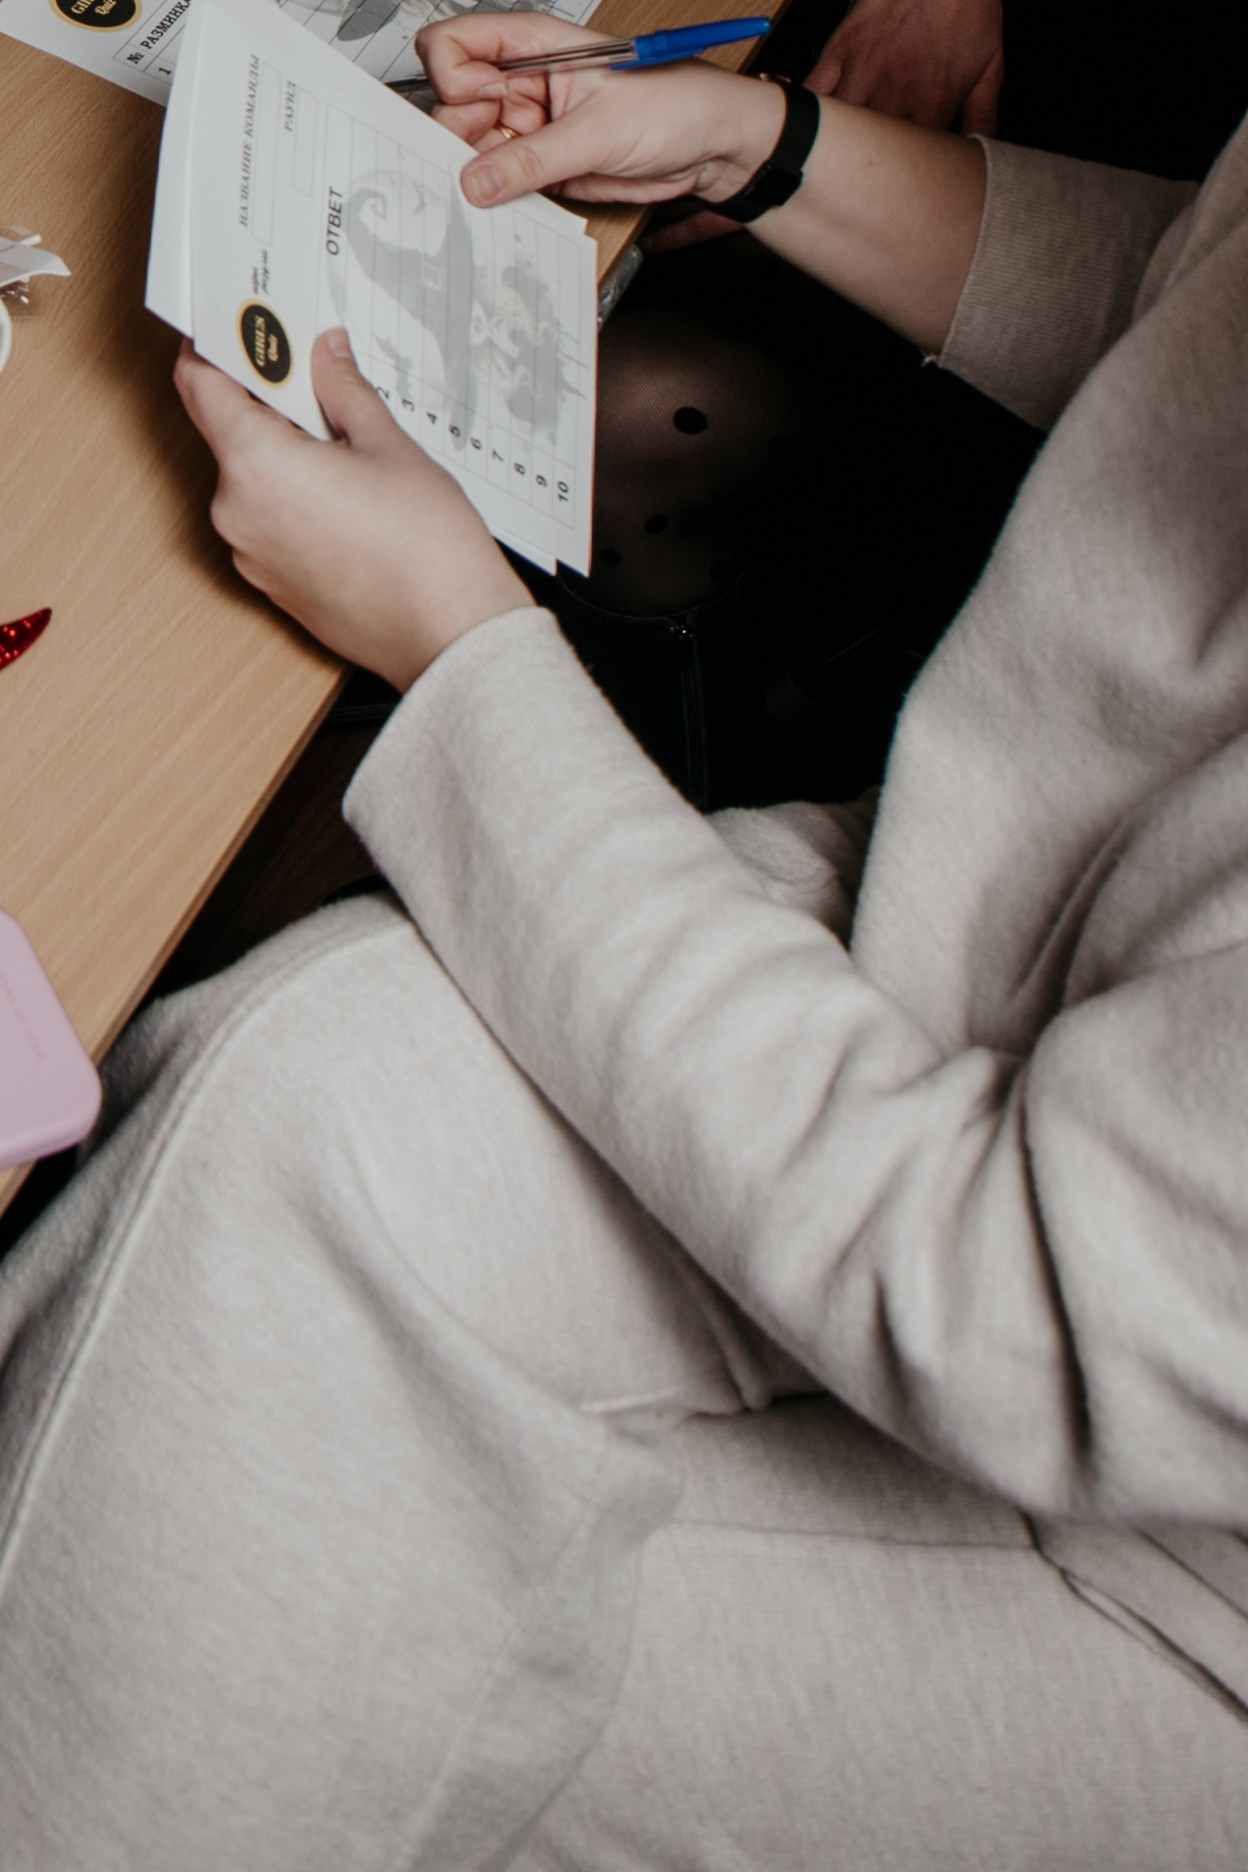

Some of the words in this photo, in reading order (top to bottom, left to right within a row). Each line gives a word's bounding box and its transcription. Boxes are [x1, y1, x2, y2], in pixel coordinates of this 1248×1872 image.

[126, 51, 145, 65] №
[158, 66, 172, 75] 1
[244, 54, 260, 138] КОМАНДЫ
[284, 80, 297, 133] РАУНД
[239, 139, 252, 228] НАЗВАНИЕ
[326, 185, 344, 257] ОТВЕТ
[255, 314, 266, 367] GIRL'S
[376, 386, 390, 400] 2
[402, 398, 415, 412] 3
[426, 411, 438, 424] 4
[448, 424, 461, 438] 5
[470, 437, 482, 450] 6
[492, 449, 504, 463] 7
[514, 462, 526, 476] 8
[535, 475, 548, 487] 9
[557, 481, 569, 503] 10
